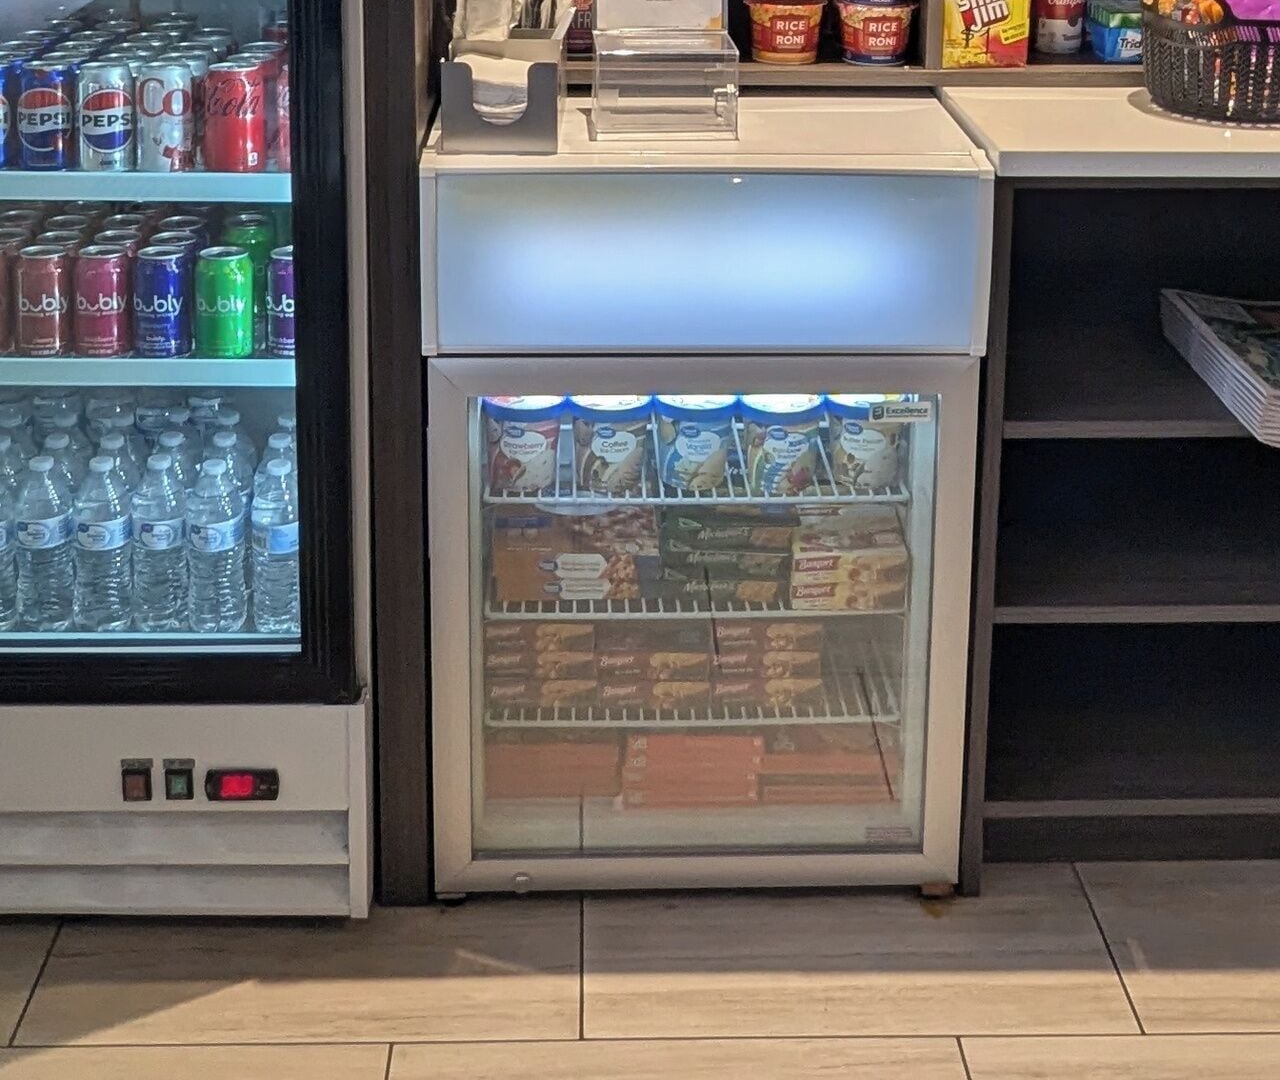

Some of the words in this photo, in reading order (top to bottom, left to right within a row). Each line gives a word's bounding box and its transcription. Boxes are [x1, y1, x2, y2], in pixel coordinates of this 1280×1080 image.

[970, 0, 1009, 31] Jim
[776, 21, 806, 31] RICE
[868, 22, 898, 33] RICE
[776, 35, 805, 45] RONI
[868, 36, 897, 46] RONI
[1119, 38, 1141, 49] Trid
[19, 293, 70, 313] bubly
[76, 291, 127, 312] bubly
[133, 293, 184, 316] bubly
[196, 294, 247, 313] bubly
[885, 406, 929, 414] Excellence
[503, 441, 544, 449] Strawberry
[601, 440, 628, 448] Coffee
[795, 586, 832, 598] Banquet
